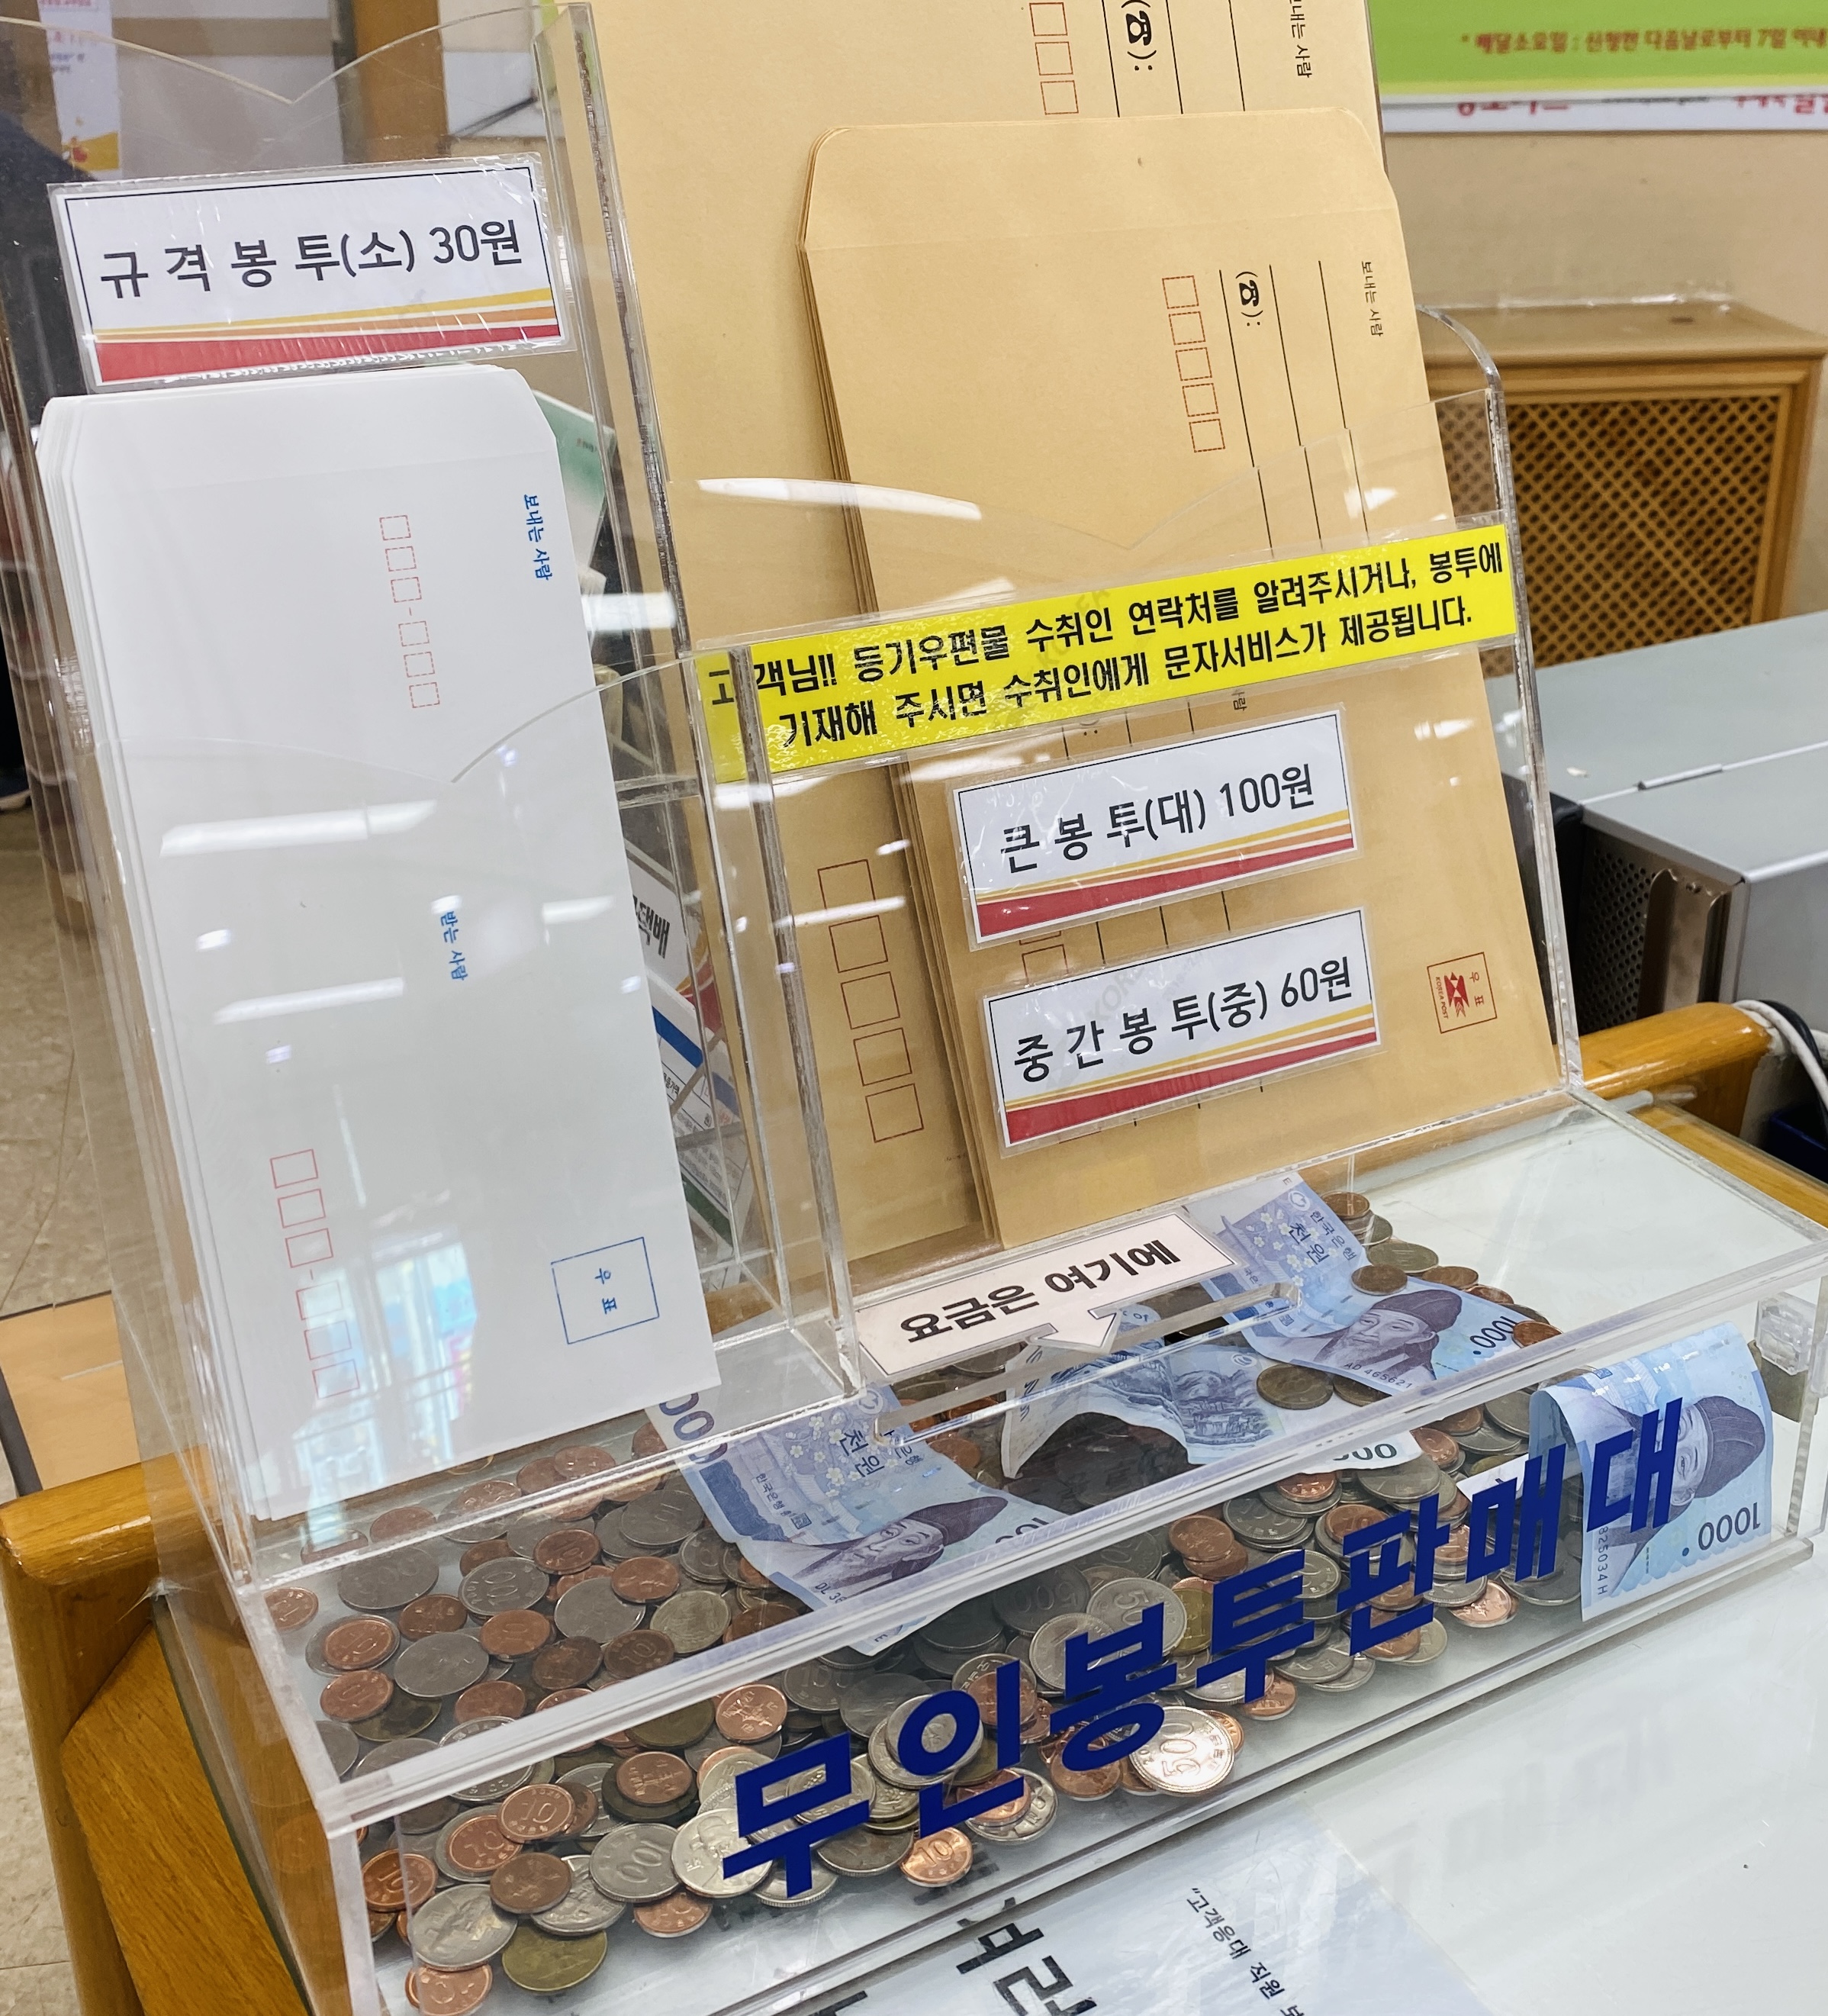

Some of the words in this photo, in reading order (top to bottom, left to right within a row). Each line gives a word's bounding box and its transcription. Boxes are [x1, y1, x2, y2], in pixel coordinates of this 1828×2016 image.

[1289, 0, 1305, 39] 내는
[1295, 44, 1312, 78] 사람
[429, 218, 523, 266] 30원
[1361, 260, 1376, 304] 보내는
[1369, 309, 1383, 337] 사람
[523, 494, 544, 543] 보내는
[533, 548, 553, 581] 사람
[708, 652, 837, 706] 고객님!!
[854, 625, 1009, 684] 등기우편물
[1025, 607, 1114, 653] 수취인
[1128, 587, 1238, 636] 연락처를
[1254, 557, 1417, 614] 알려주시거나,
[1428, 541, 1503, 585] 봉투에
[778, 699, 878, 749] 기재해
[896, 678, 988, 729] 주시면
[1003, 653, 1150, 710] 수취인에게
[1164, 622, 1326, 681] 문자서비스가
[1340, 595, 1472, 647] 제공됩니다.
[999, 824, 1041, 874] 큰
[1218, 762, 1315, 817] 100원
[440, 911, 459, 944] 받는
[449, 950, 468, 981] 사람
[1279, 956, 1353, 1008] 60원
[1435, 976, 1444, 1000] KOREA
[900, 1285, 1040, 1343] 요금은
[1044, 1239, 1181, 1293] 여기에
[1698, 1502, 1761, 1551] 1000
[1250, 1962, 1286, 2000] 직원
